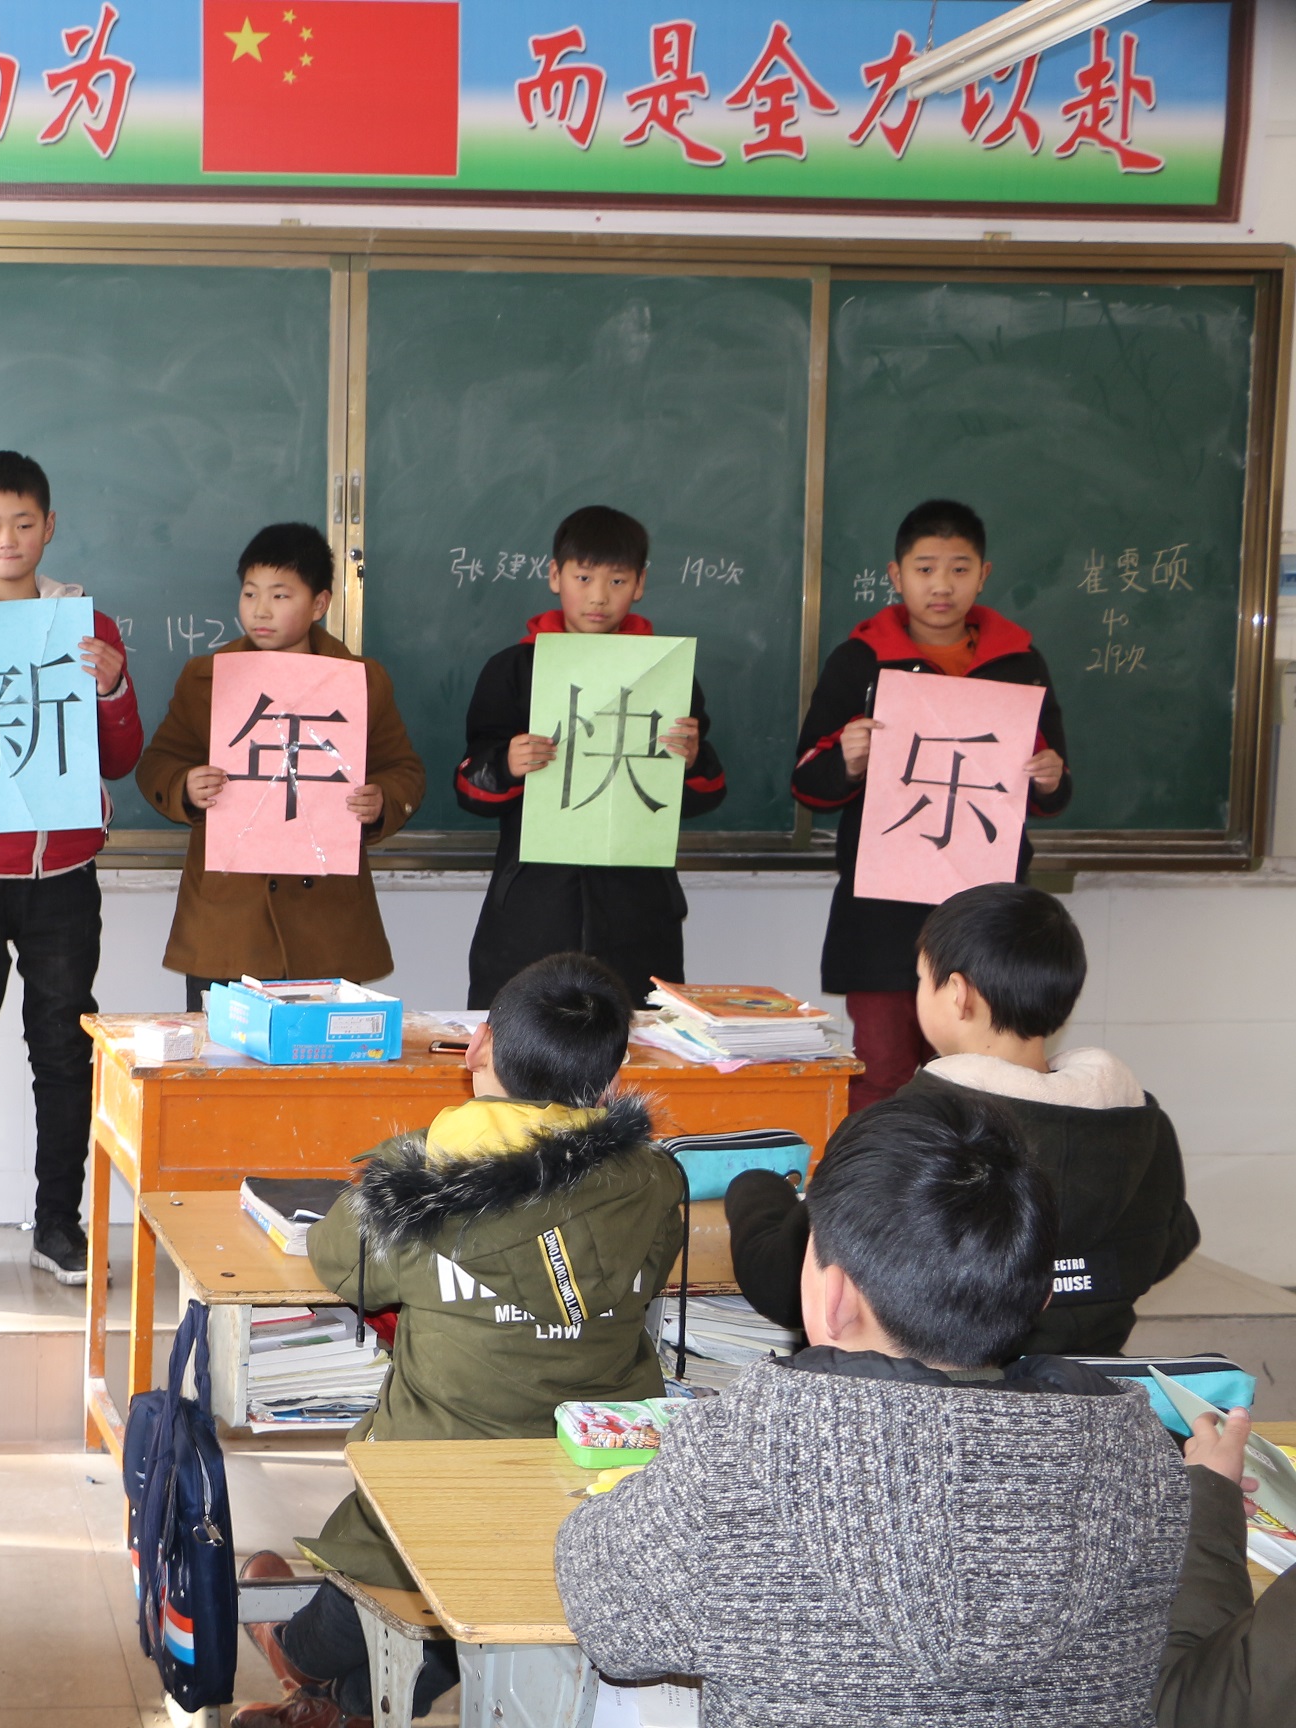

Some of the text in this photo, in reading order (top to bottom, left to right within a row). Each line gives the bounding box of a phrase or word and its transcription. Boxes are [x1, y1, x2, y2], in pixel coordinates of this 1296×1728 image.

[515, 19, 1165, 173] 而是全力以赴
[226, 692, 350, 821] 年
[551, 683, 673, 813] 快
[881, 732, 1009, 850] 乐
[1053, 1257, 1085, 1271] ECTRO
[1053, 1275, 1092, 1293] OUSE
[535, 1323, 582, 1339] LHW
